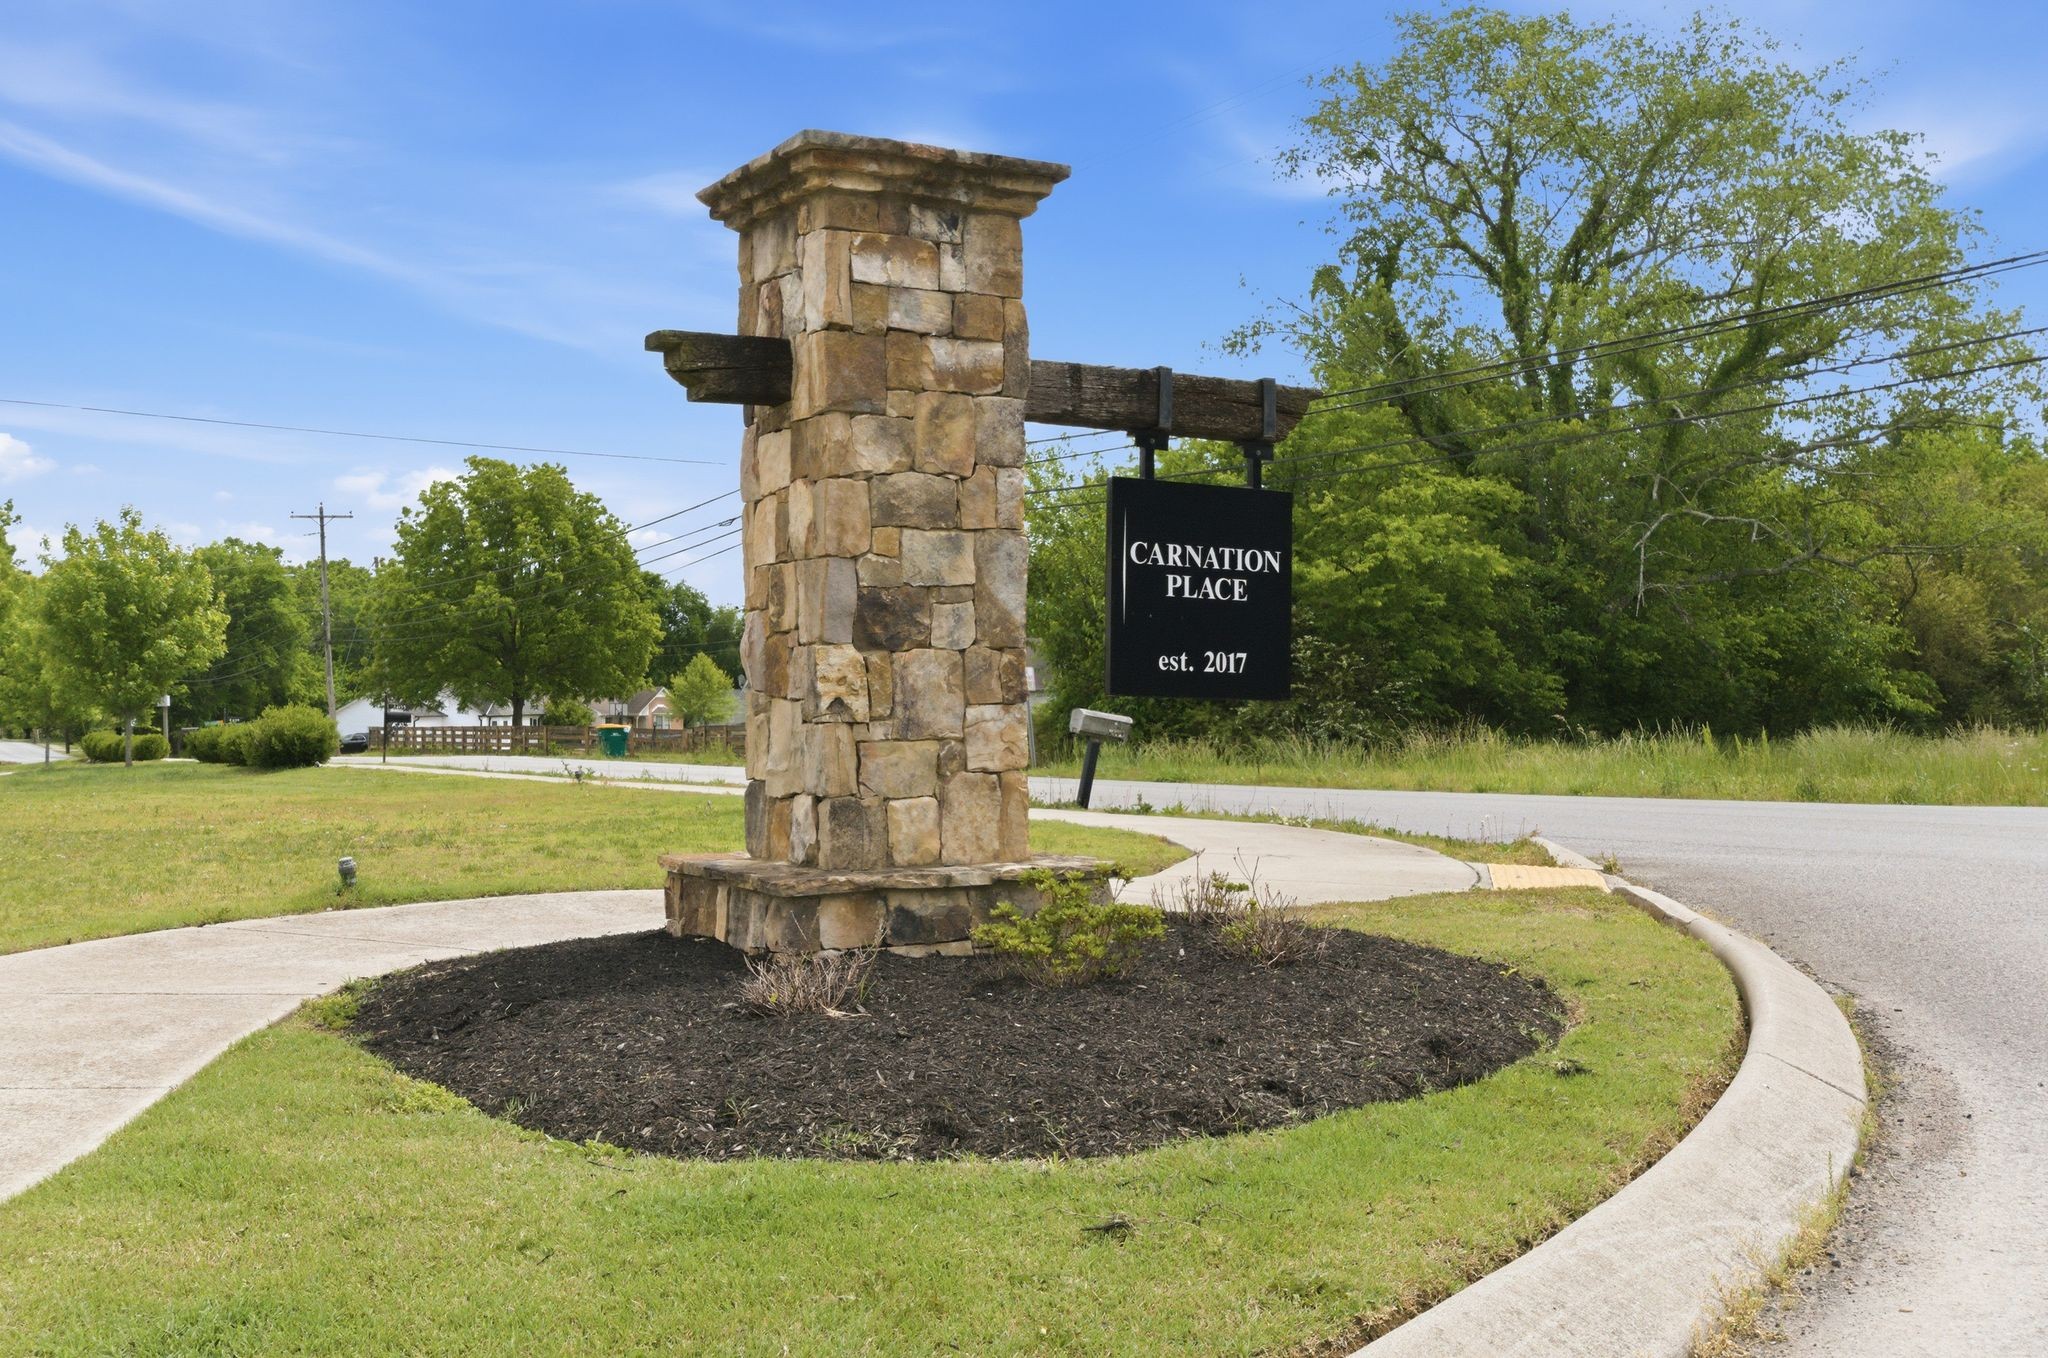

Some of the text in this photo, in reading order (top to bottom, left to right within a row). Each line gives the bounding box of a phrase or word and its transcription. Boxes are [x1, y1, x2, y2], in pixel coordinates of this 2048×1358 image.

[1129, 541, 1282, 573] CARNATION
[1165, 574, 1248, 602] PLACE
[1158, 651, 1248, 674] est. 2017
